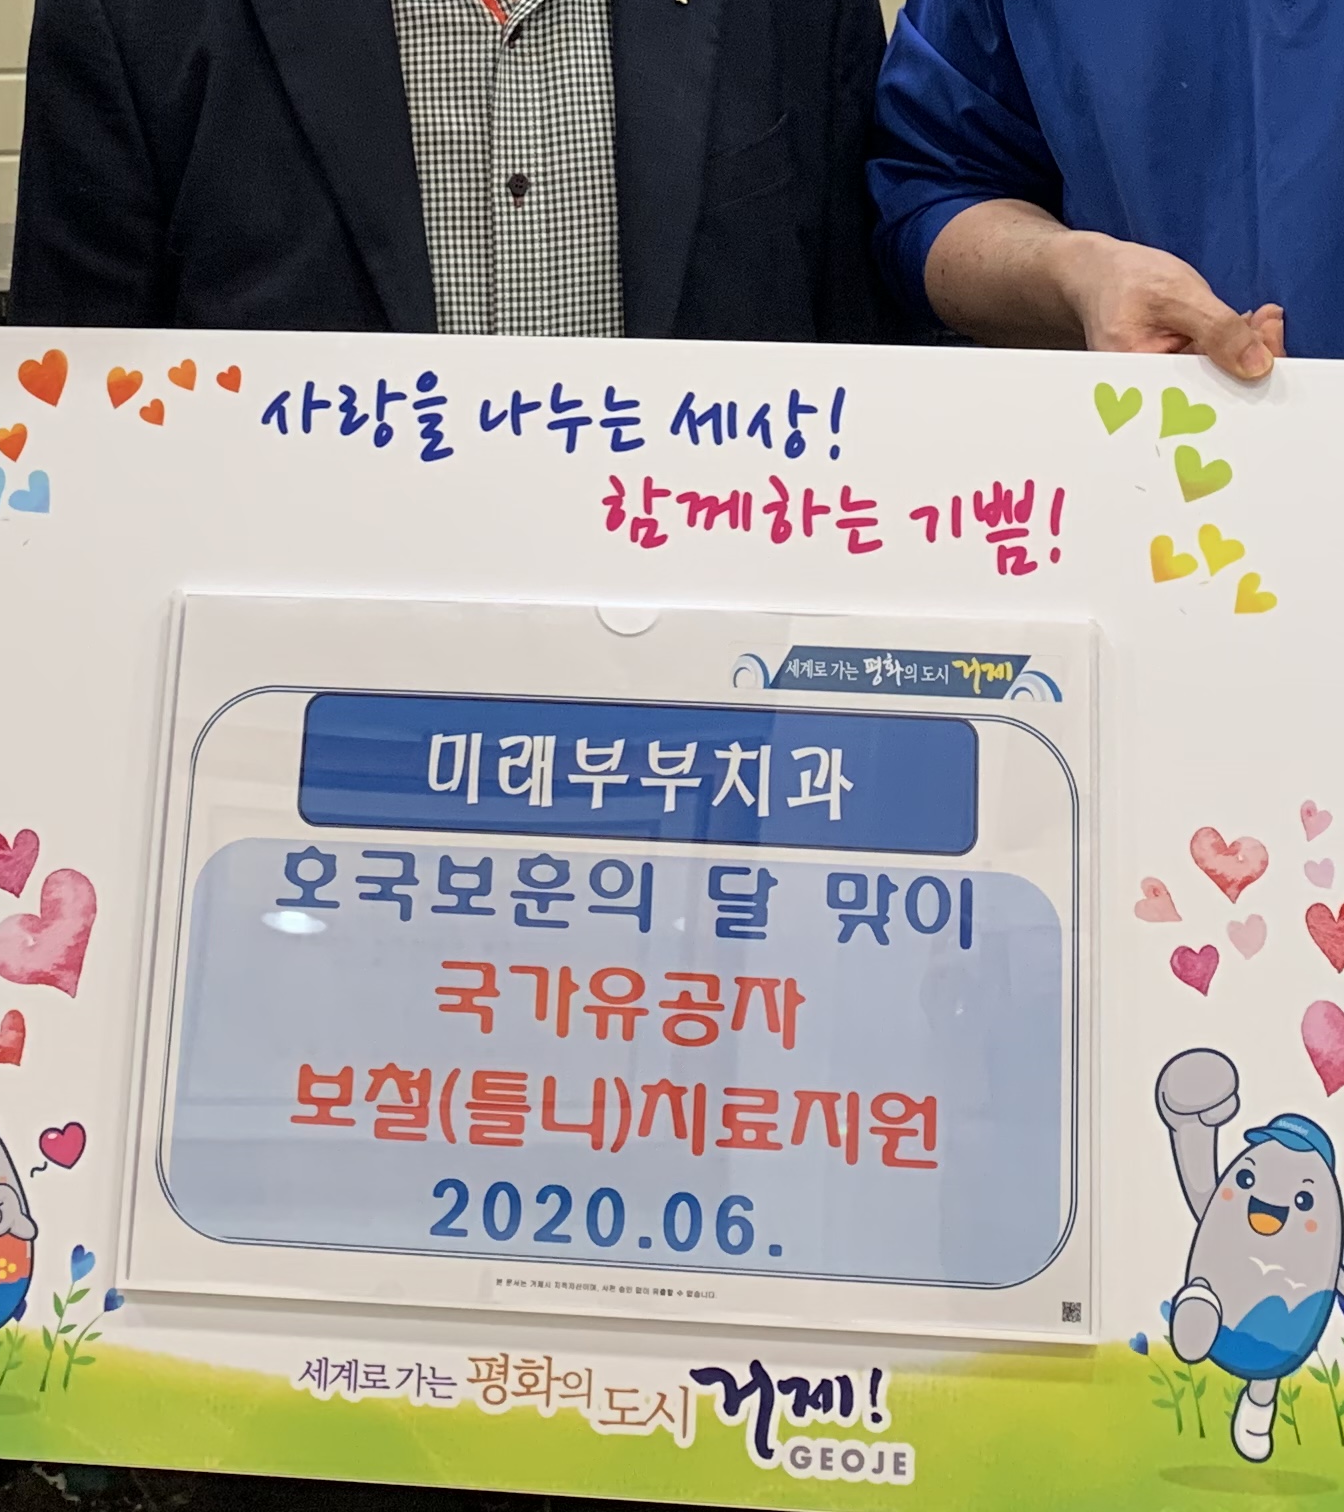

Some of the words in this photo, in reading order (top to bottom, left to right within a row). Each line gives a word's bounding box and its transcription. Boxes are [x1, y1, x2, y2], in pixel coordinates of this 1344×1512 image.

[262, 371, 454, 462] 사랑을
[480, 382, 645, 454] 나누는
[670, 386, 846, 461] 세상!
[602, 475, 883, 554] 함께하는
[909, 479, 1066, 576] 기쁨!
[785, 658, 828, 679] 세계로
[831, 660, 860, 681] 가는
[863, 653, 918, 687] 평화의
[921, 664, 949, 685] 도시
[952, 657, 1014, 695] 거제
[427, 731, 855, 821] 미래부부치과
[276, 846, 654, 934] 호국보훈의
[706, 865, 779, 941] 달
[826, 871, 974, 951] 맞이
[435, 960, 806, 1051] 국가유공자
[290, 1063, 939, 1170] 보철(틀니)치료지원
[429, 1178, 784, 1257] 2020.06.
[297, 1357, 391, 1393] 세계로
[395, 1362, 458, 1401] 가는
[465, 1352, 594, 1409] 평화의
[597, 1385, 691, 1439] 도시
[689, 1358, 885, 1460] 거제!
[788, 1444, 909, 1477] GEOJE
